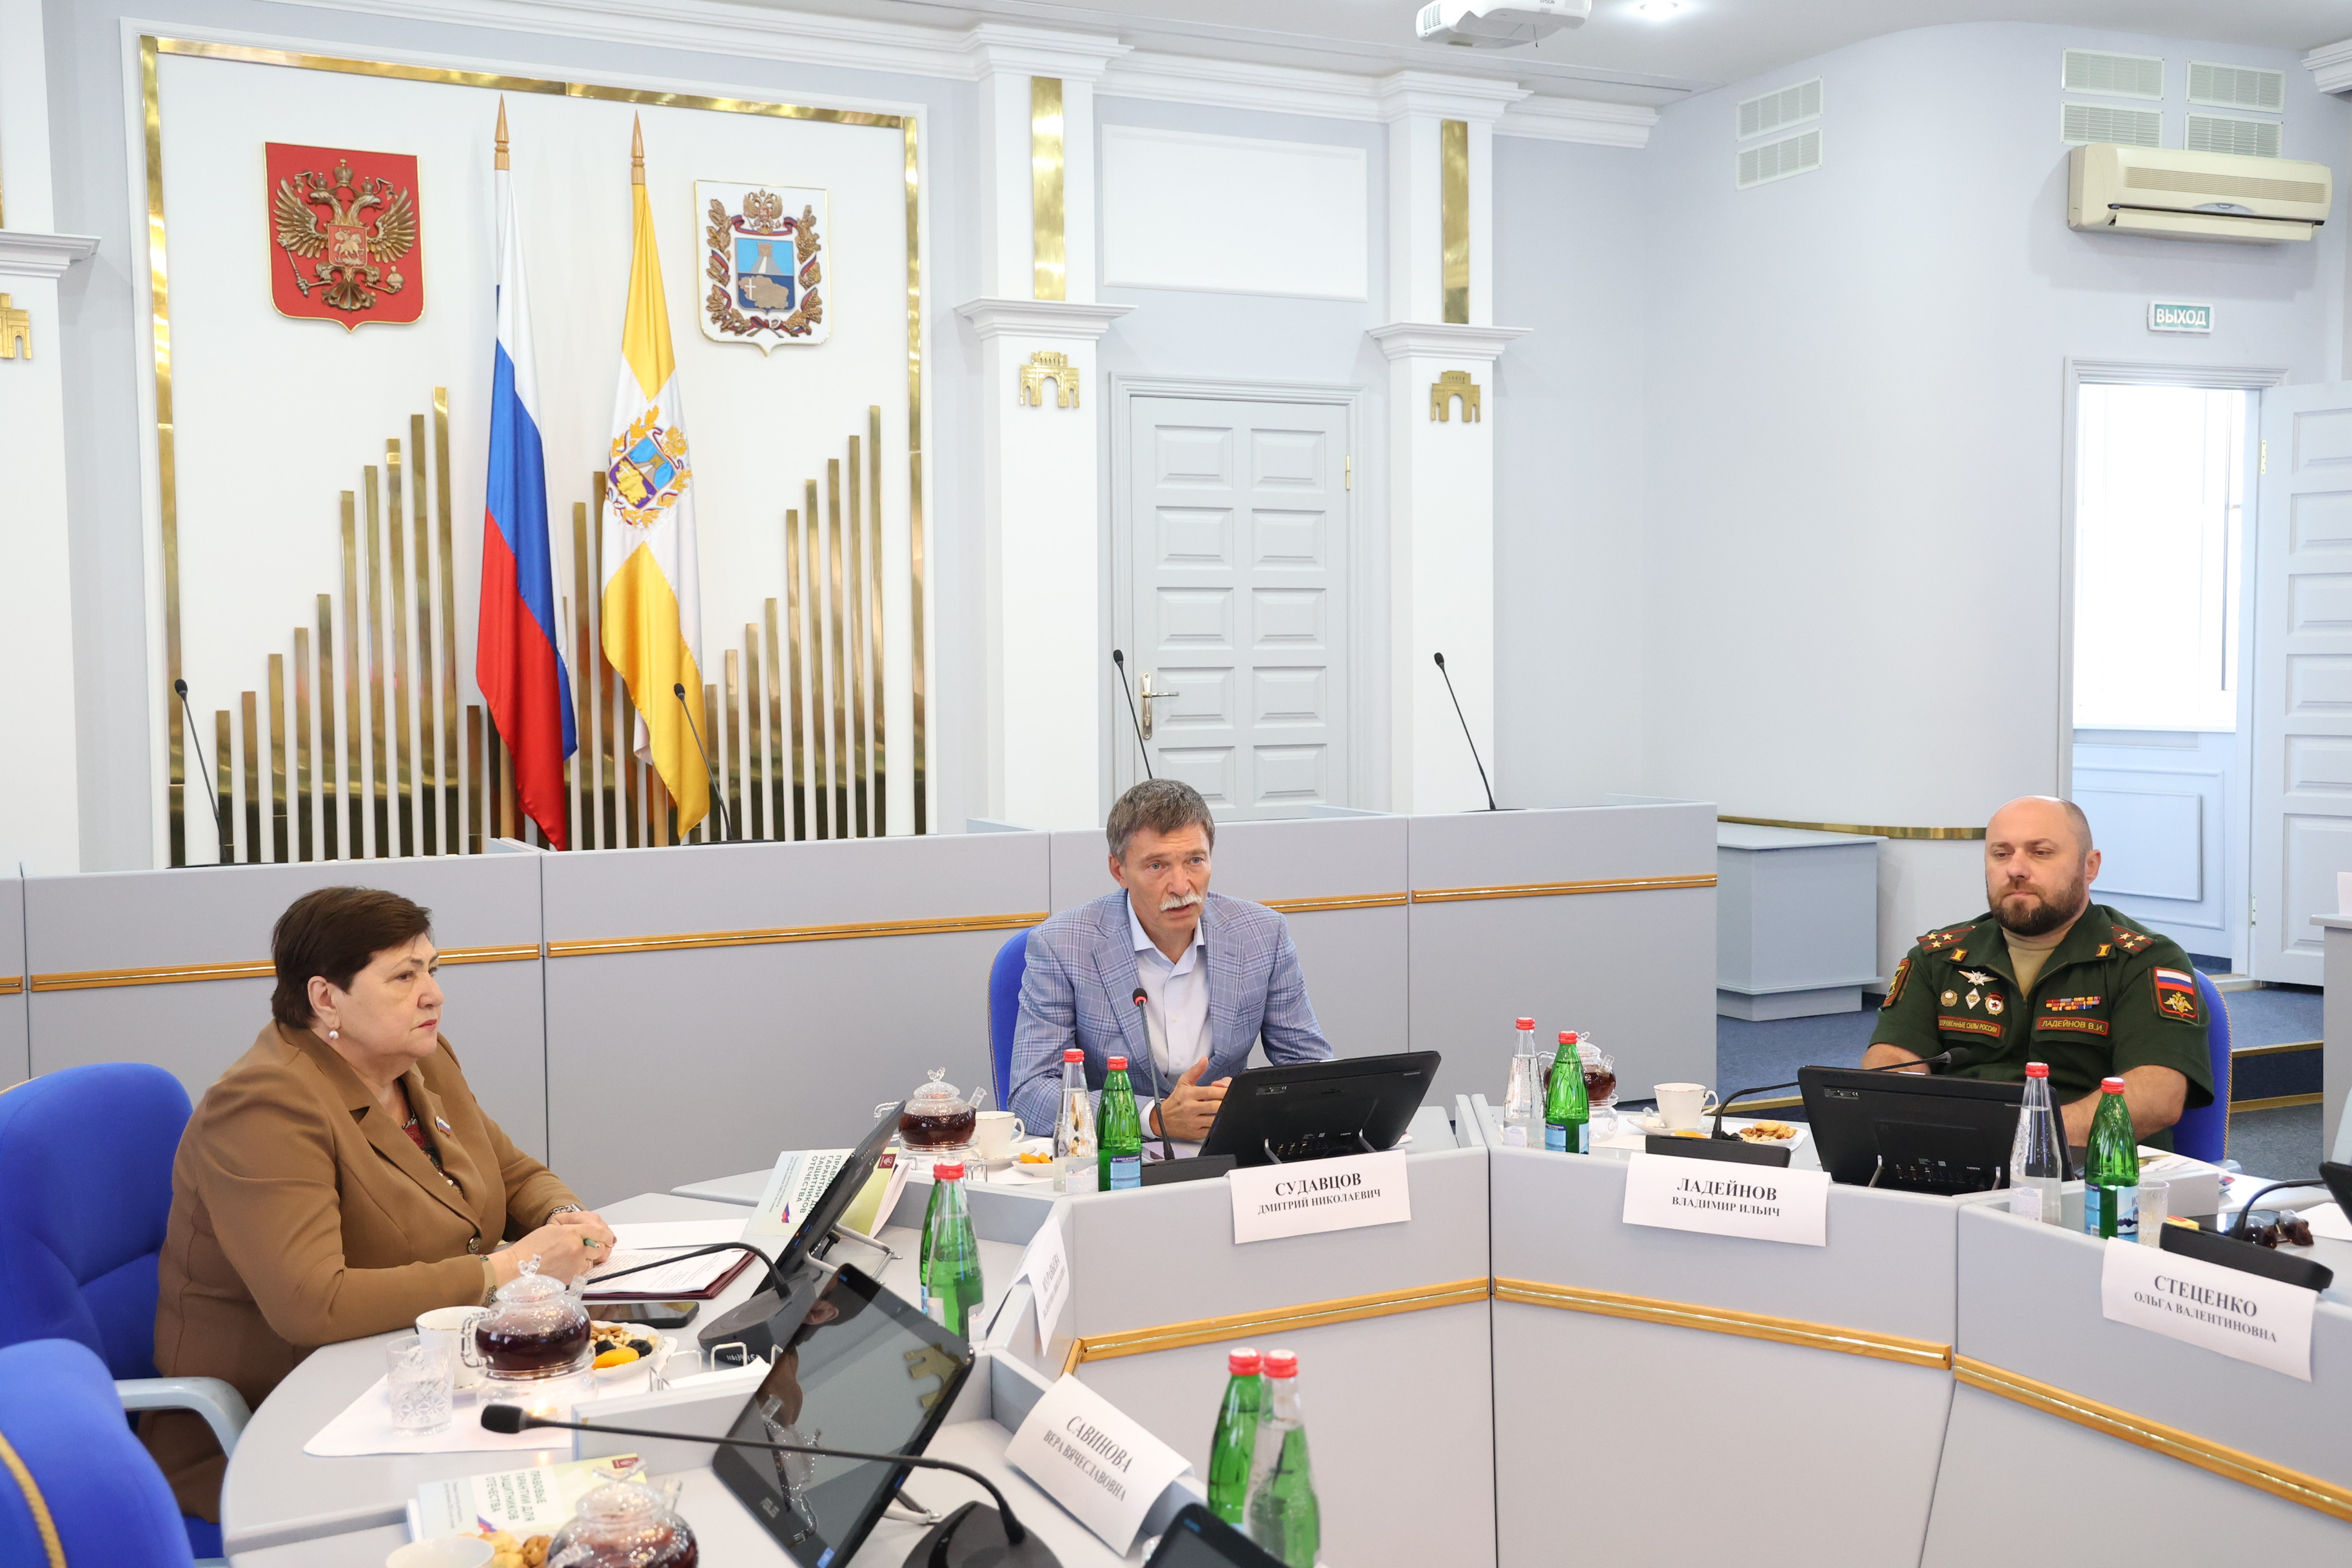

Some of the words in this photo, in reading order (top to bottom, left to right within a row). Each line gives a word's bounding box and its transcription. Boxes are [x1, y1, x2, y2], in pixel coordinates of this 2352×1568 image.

[2156, 308, 2206, 326] ВЫХОД
[1979, 1024, 1997, 1033] РОССИИ
[2041, 1019, 2086, 1028] ЛАДЕЙНОВ
[2088, 1023, 2104, 1032] В.И.
[796, 1155, 818, 1202] ОТЕЧЕСТВА
[799, 1156, 826, 1213] ЗАЩИТНИКОВ
[814, 1155, 834, 1197] ГАРАНТИИ
[825, 1155, 842, 1190] ПРАВОВ
[1275, 1173, 1362, 1196] СУДАВЦОВ
[1677, 1178, 1778, 1200] ЛАДЕЙНОВ
[1258, 1197, 1309, 1215] ДМИТРИЙ
[1311, 1189, 1382, 1206] НИКОЛАЕВИЧ
[1672, 1196, 1736, 1211] ВЛАДИМИР
[1739, 1204, 1780, 1217] ИЛЬИЧ
[2154, 1275, 2257, 1317] СТЕЦЕНКО
[2134, 1291, 2172, 1311] ОЛЬГА
[2176, 1303, 2277, 1342] ВАЛЕНТИНОВНА
[1066, 1416, 1133, 1473] САВИНОВА
[1043, 1429, 1064, 1452] ВЕРА
[1063, 1444, 1126, 1501] ВЯЧЕСЛАВОВНА
[485, 1476, 501, 1513] ОТЕЧЕСТВА
[500, 1474, 519, 1521] ЗАЩИТНИКОВ
[515, 1472, 531, 1504] ГАРАНТИИ
[530, 1470, 547, 1504] ПРАВОВЫЕ
[521, 1505, 534, 1522] ДЛЯ
